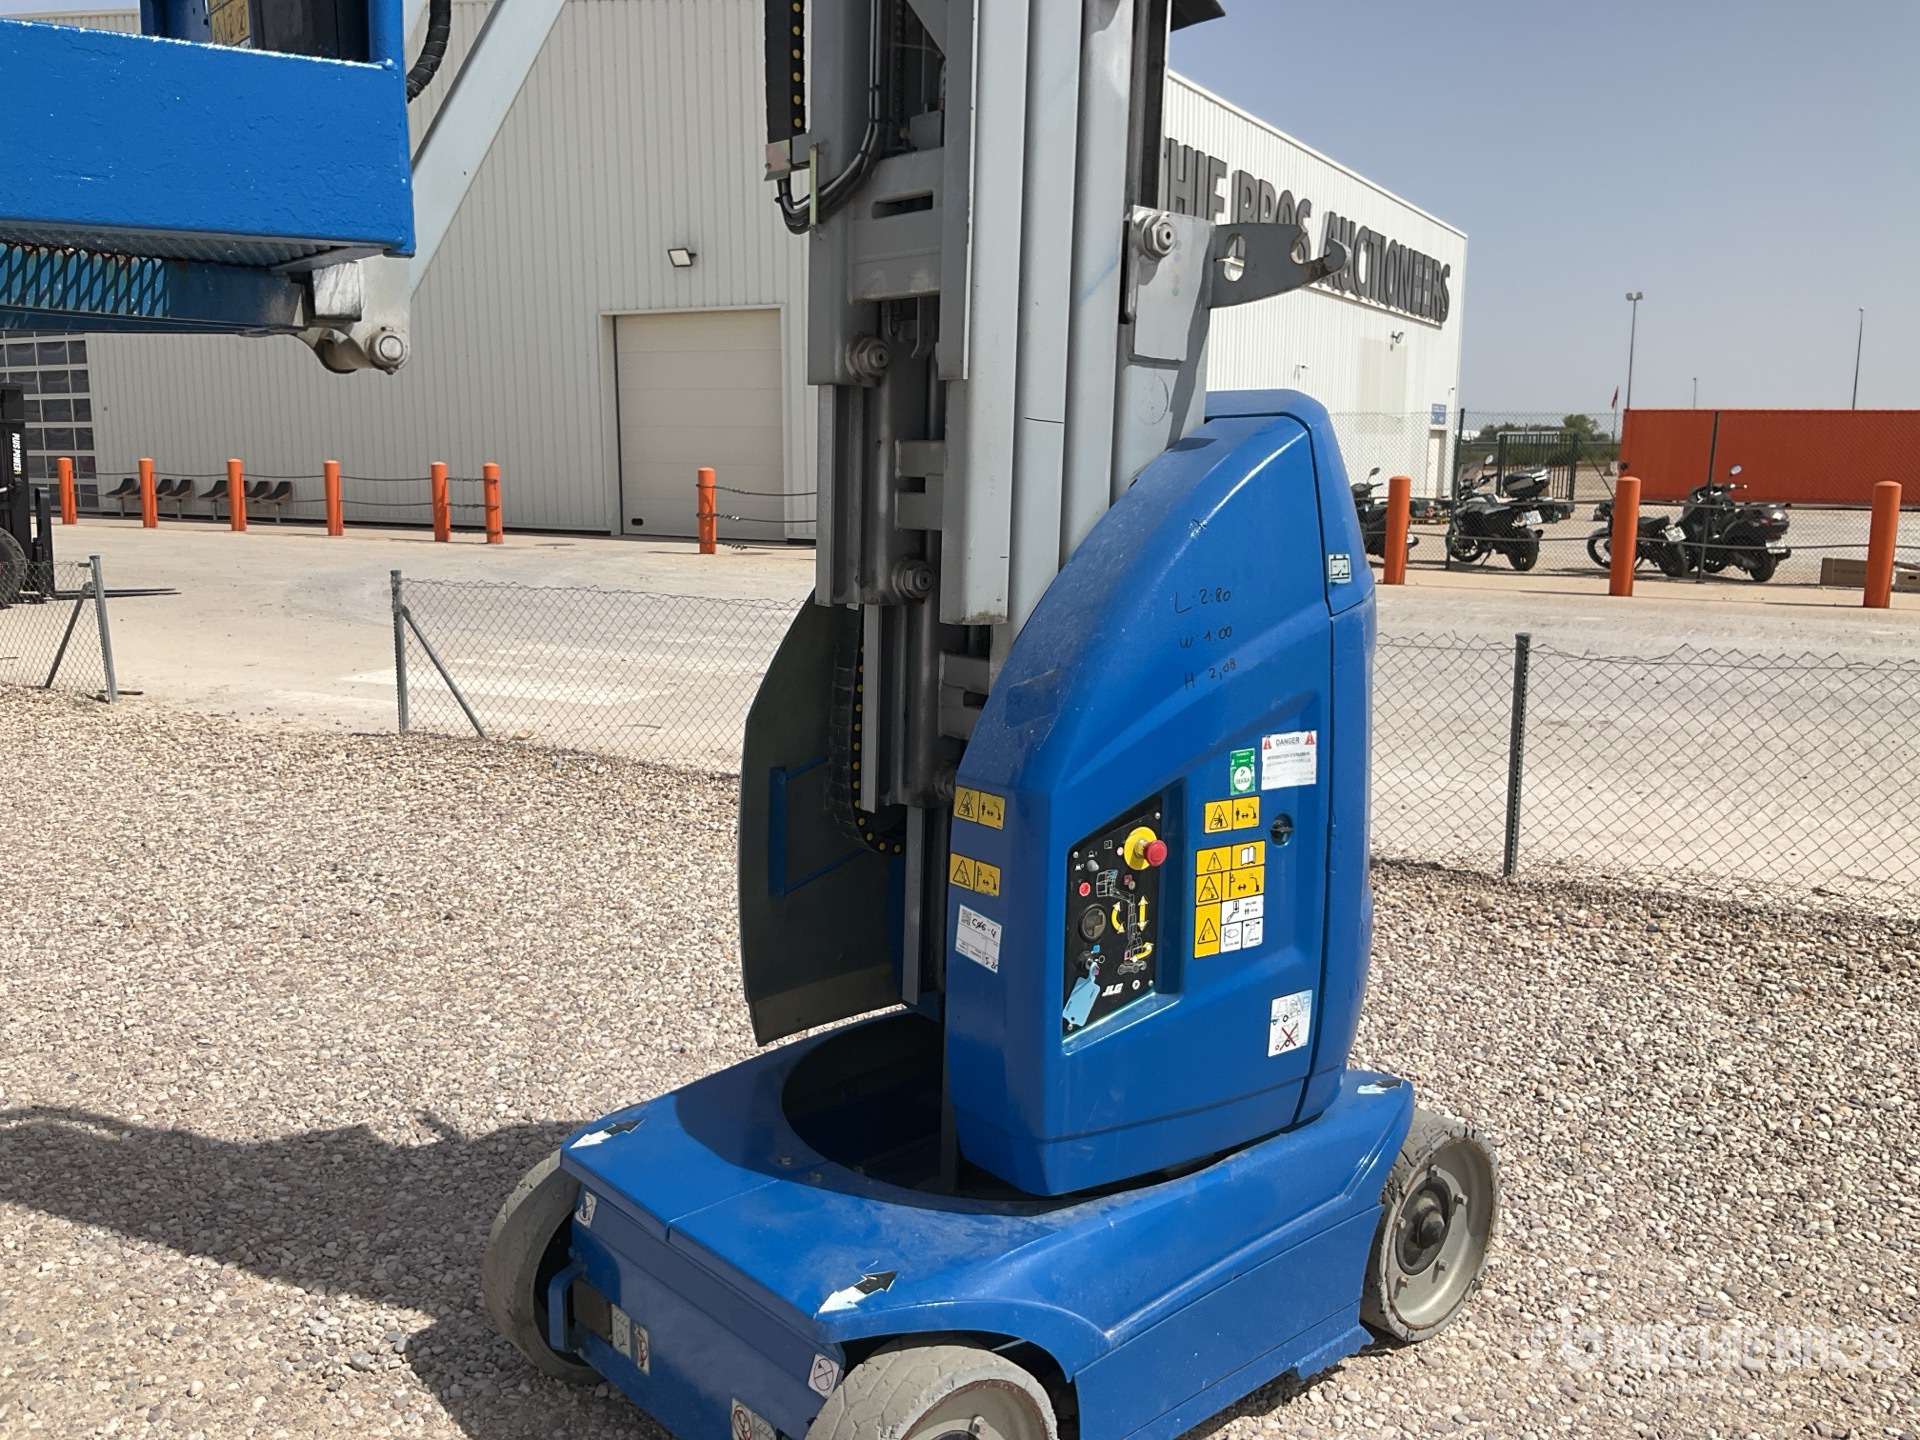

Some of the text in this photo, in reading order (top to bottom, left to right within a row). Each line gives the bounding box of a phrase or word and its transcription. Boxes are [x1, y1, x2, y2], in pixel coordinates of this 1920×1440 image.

[1161, 136, 1227, 221] HIE
[1318, 211, 1451, 323] AUCTIONEERS
[1275, 736, 1300, 746] DANGER
[1101, 982, 1124, 997] JLG
